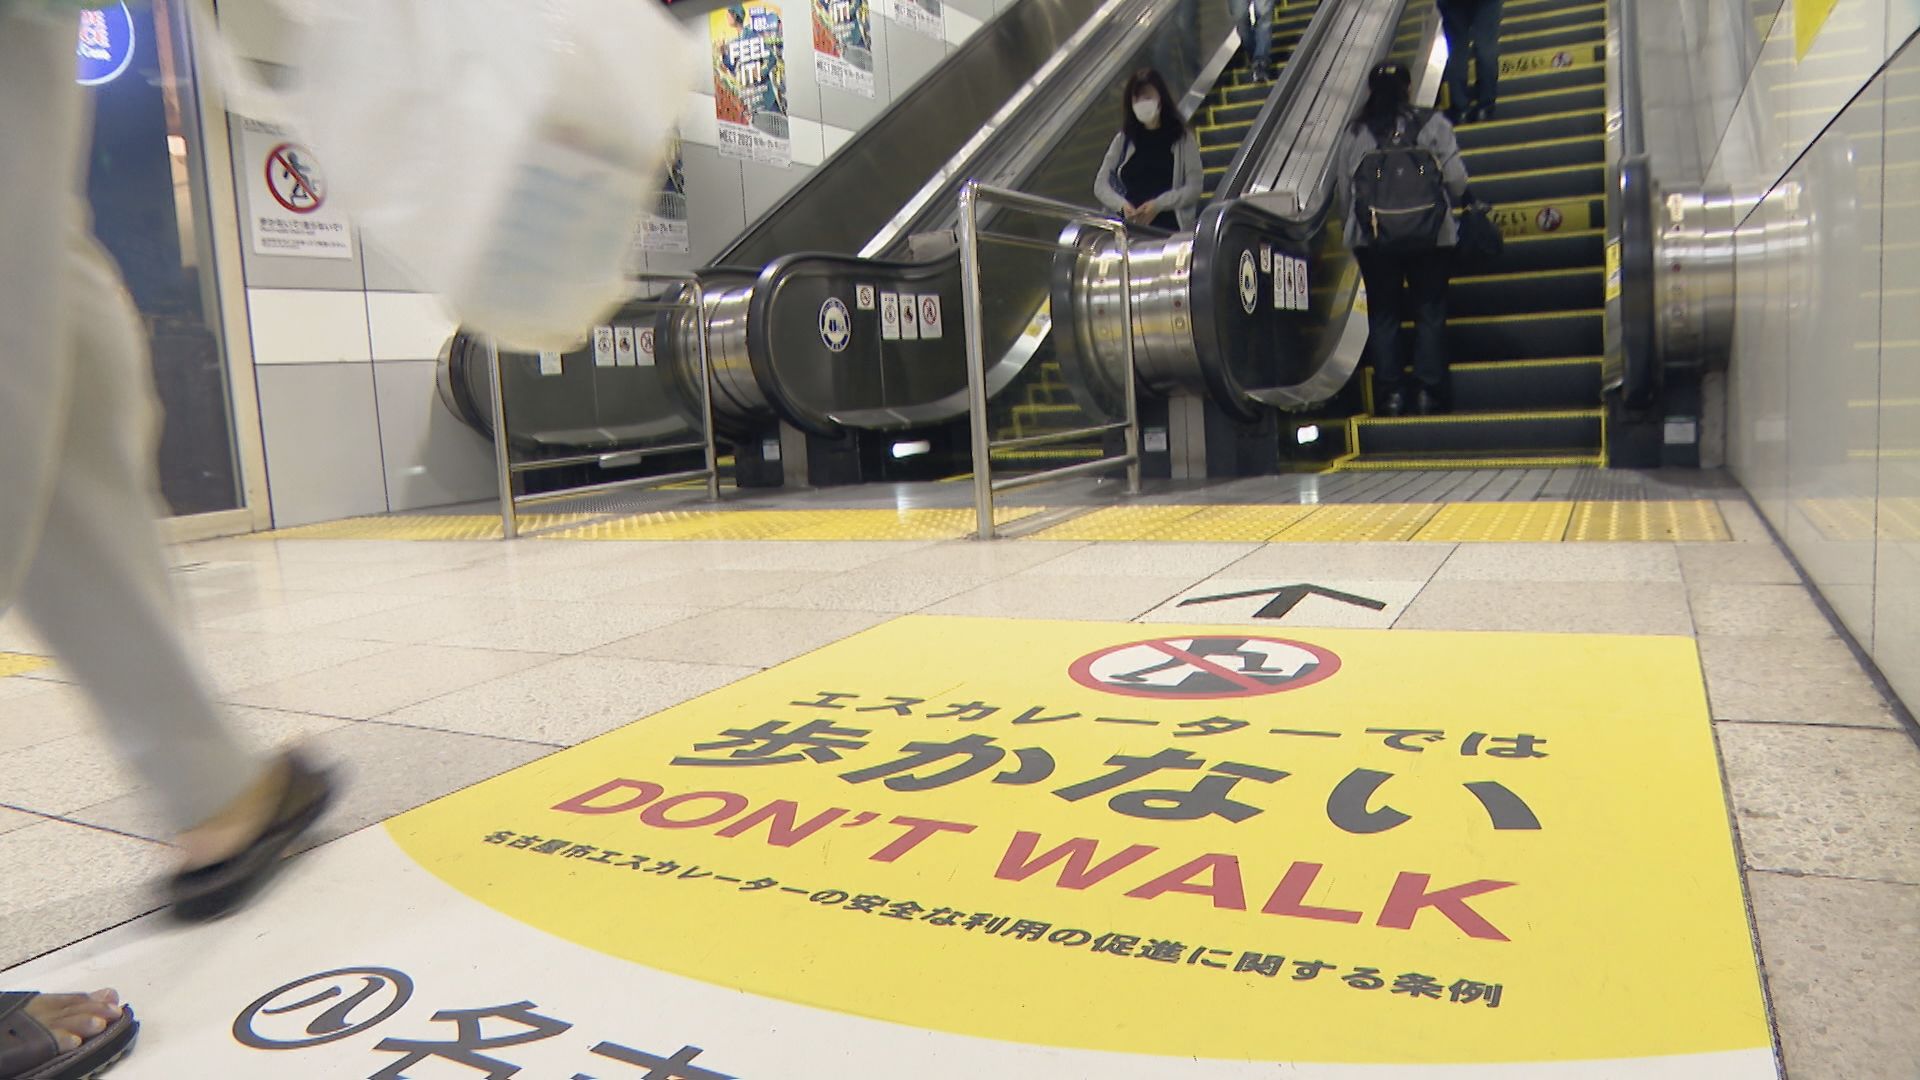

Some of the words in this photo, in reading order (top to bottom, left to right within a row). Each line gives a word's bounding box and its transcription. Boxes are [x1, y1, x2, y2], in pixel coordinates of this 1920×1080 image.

[729, 37, 770, 66] FEEL
[740, 61, 762, 86] IT!
[789, 692, 1548, 758] エスカレーターでは
[671, 719, 1542, 834] 歩かない
[483, 829, 1503, 1009] 名古屋市エスカレーターの安全な利用の促進に関する条例
[995, 831, 1516, 943] WALK
